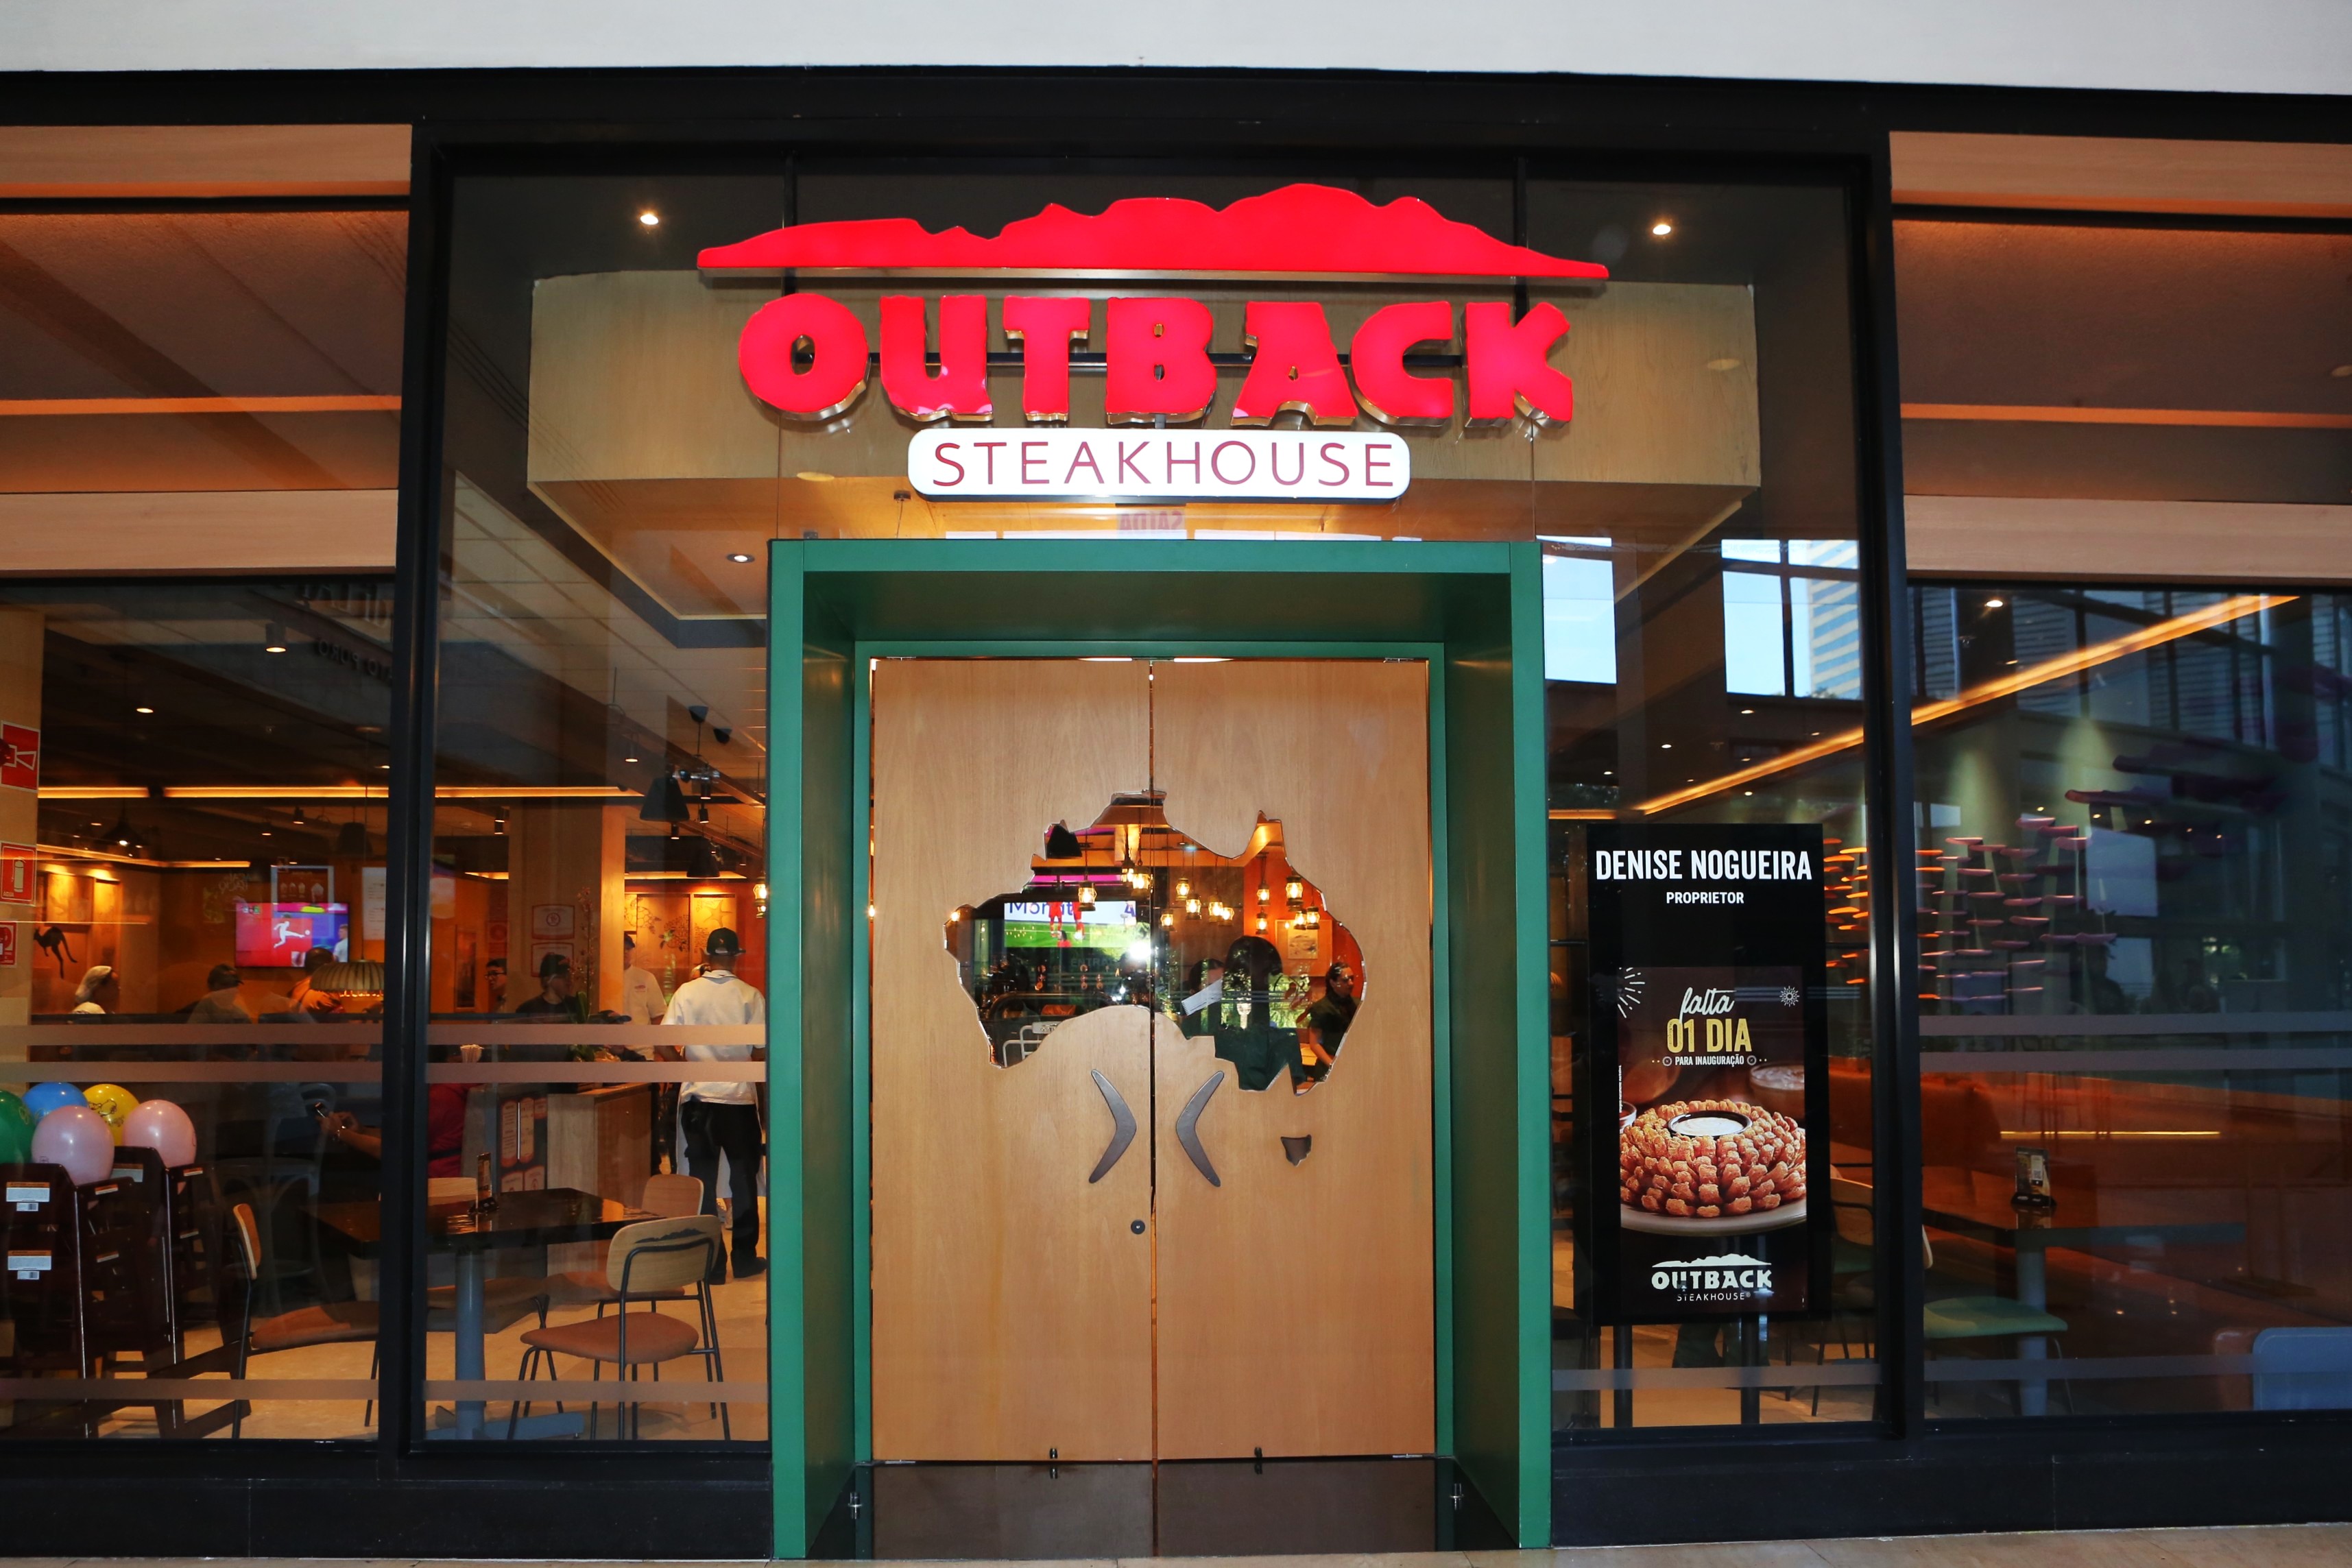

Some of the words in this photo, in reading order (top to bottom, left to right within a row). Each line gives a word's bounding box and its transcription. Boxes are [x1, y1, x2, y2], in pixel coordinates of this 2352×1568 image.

[739, 293, 1573, 425] OUTBACK
[933, 440, 1393, 487] STEAKHOUSE
[1596, 849, 1683, 880] DENISE
[1691, 849, 1812, 880] NOGUEIRA
[1666, 891, 1745, 904] PROPRIETOR
[1679, 987, 1737, 1025] falta
[1667, 1018, 1695, 1054] 01
[1706, 1018, 1753, 1052] DIA
[1675, 1056, 1694, 1065] PARA
[1695, 1054, 1744, 1068] INAUGURAÇÃO
[1651, 1269, 1773, 1290] OUTBACK
